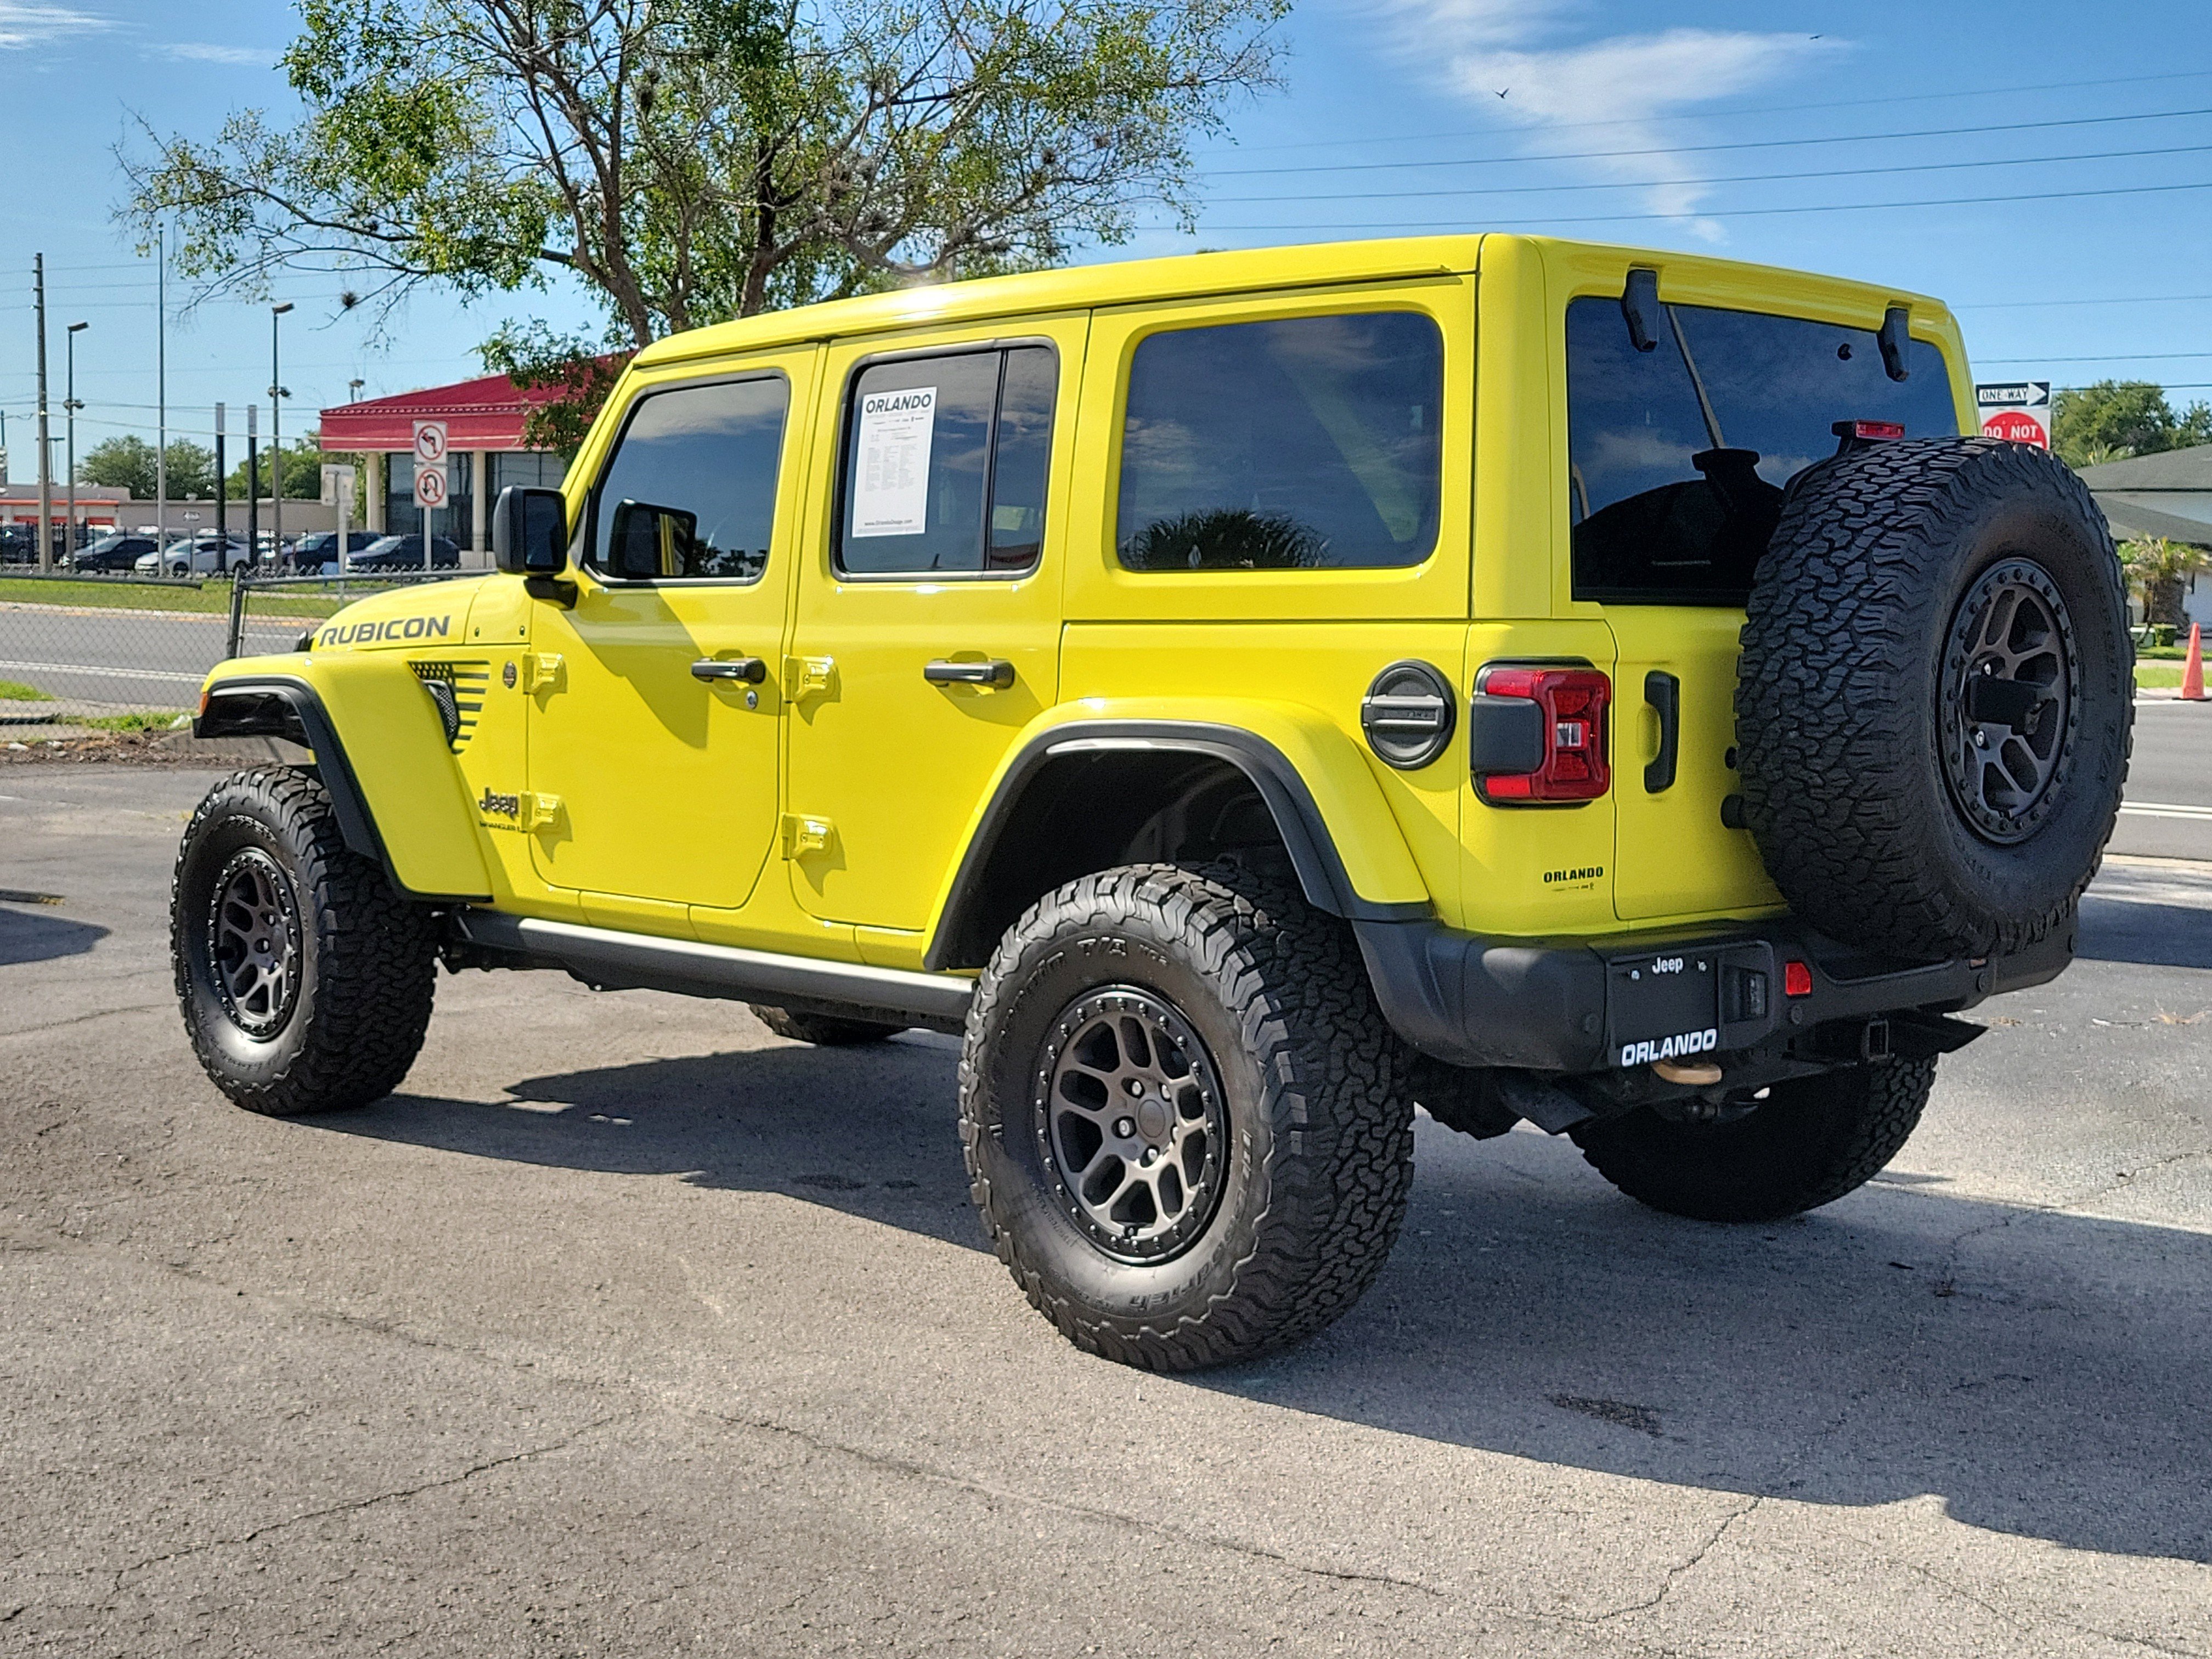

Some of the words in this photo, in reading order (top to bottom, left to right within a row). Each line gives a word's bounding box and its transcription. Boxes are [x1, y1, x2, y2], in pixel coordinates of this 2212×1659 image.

[866, 393, 932, 414] ORLANDO
[1982, 389, 2001, 400] ONE
[2007, 388, 2027, 400] WAY
[1984, 425, 2002, 438] DO
[2011, 425, 2038, 439] NOT
[319, 615, 451, 647] RUBICON
[478, 787, 518, 822] Jeep
[1543, 866, 1604, 883] ORLANDO
[1651, 957, 1684, 974] Jeep
[1621, 1028, 1718, 1067] ORLANDO
